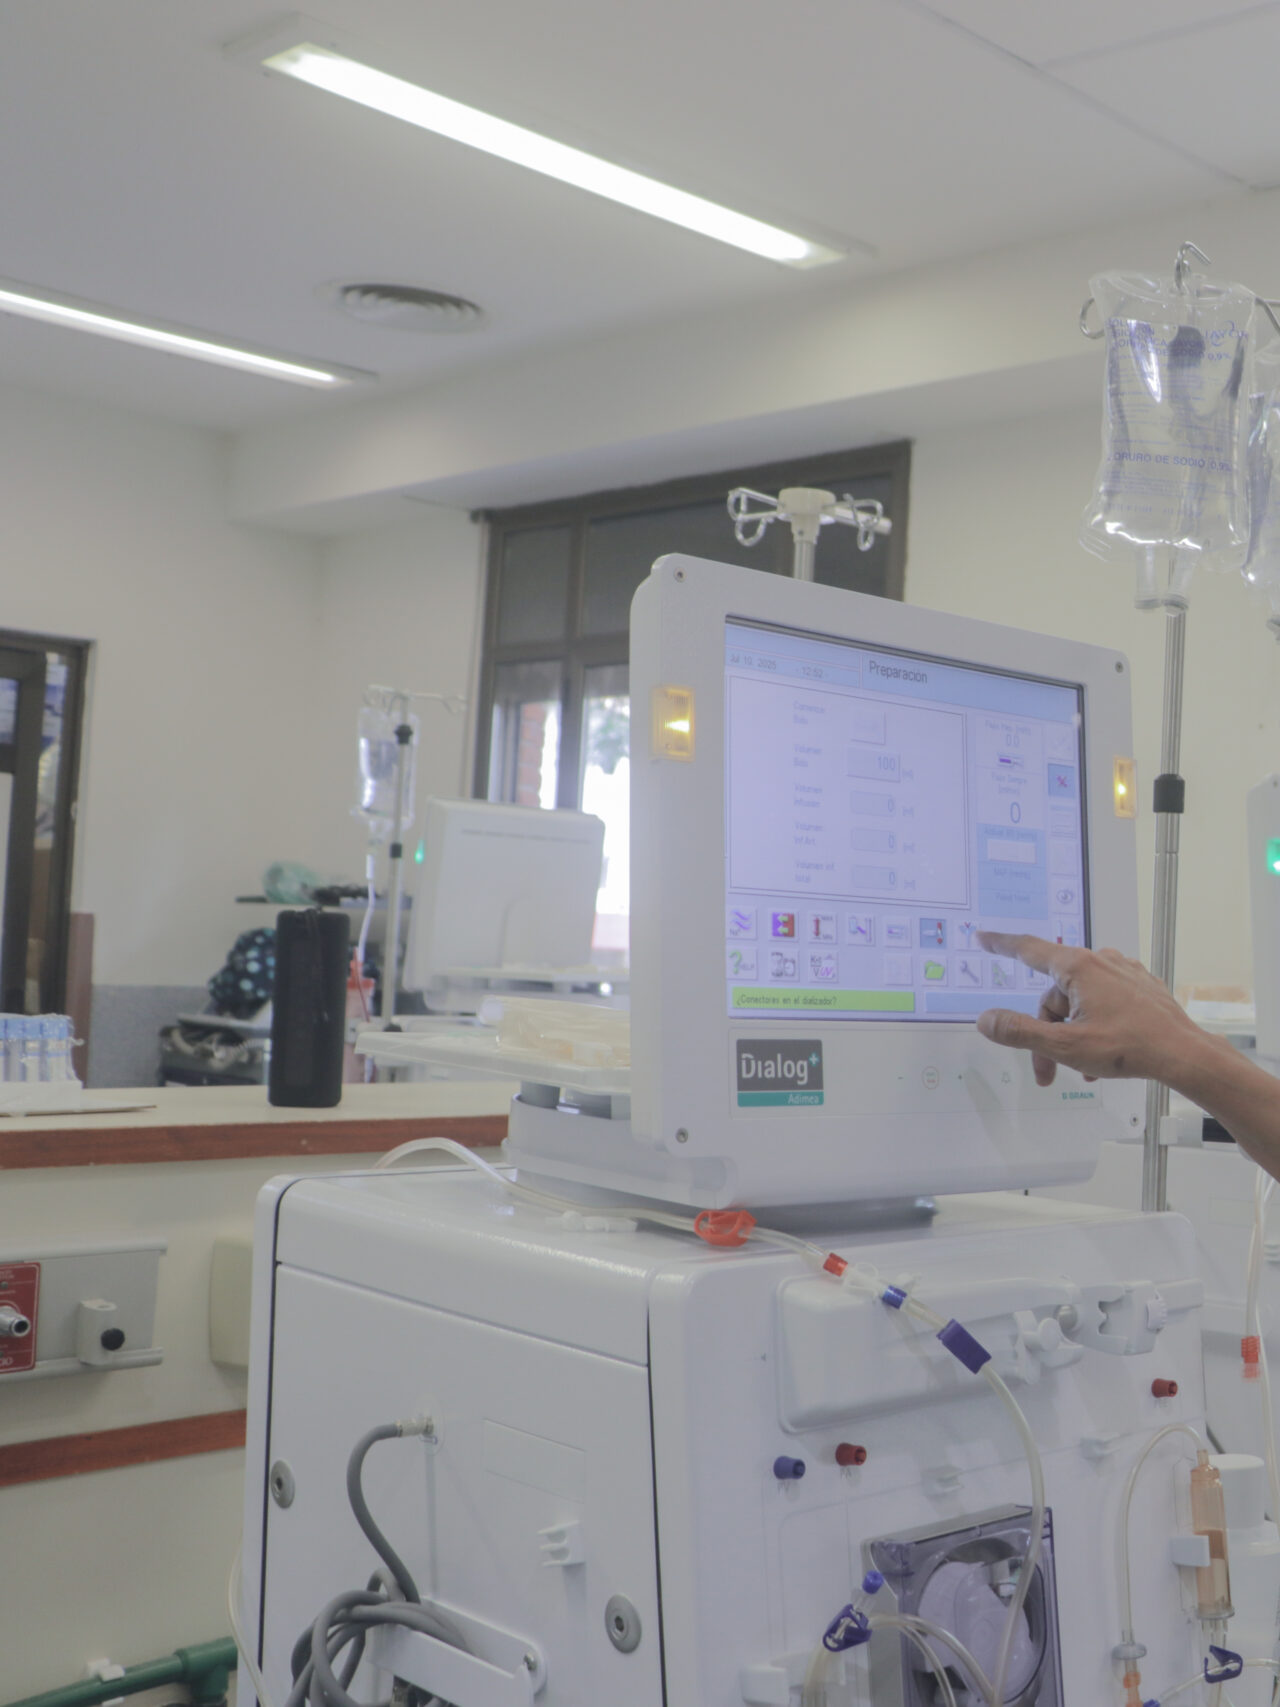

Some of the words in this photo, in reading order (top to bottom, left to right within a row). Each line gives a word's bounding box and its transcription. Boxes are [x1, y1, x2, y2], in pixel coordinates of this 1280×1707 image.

[1155, 454, 1170, 465] DE
[1173, 456, 1206, 469] SODIO
[868, 659, 929, 685] Preparación
[876, 755, 897, 772] 100
[887, 797, 896, 813] 0
[1009, 801, 1022, 824] 0
[888, 871, 896, 886] 0
[782, 996, 792, 1005] en
[787, 1091, 820, 1106] Adimea
